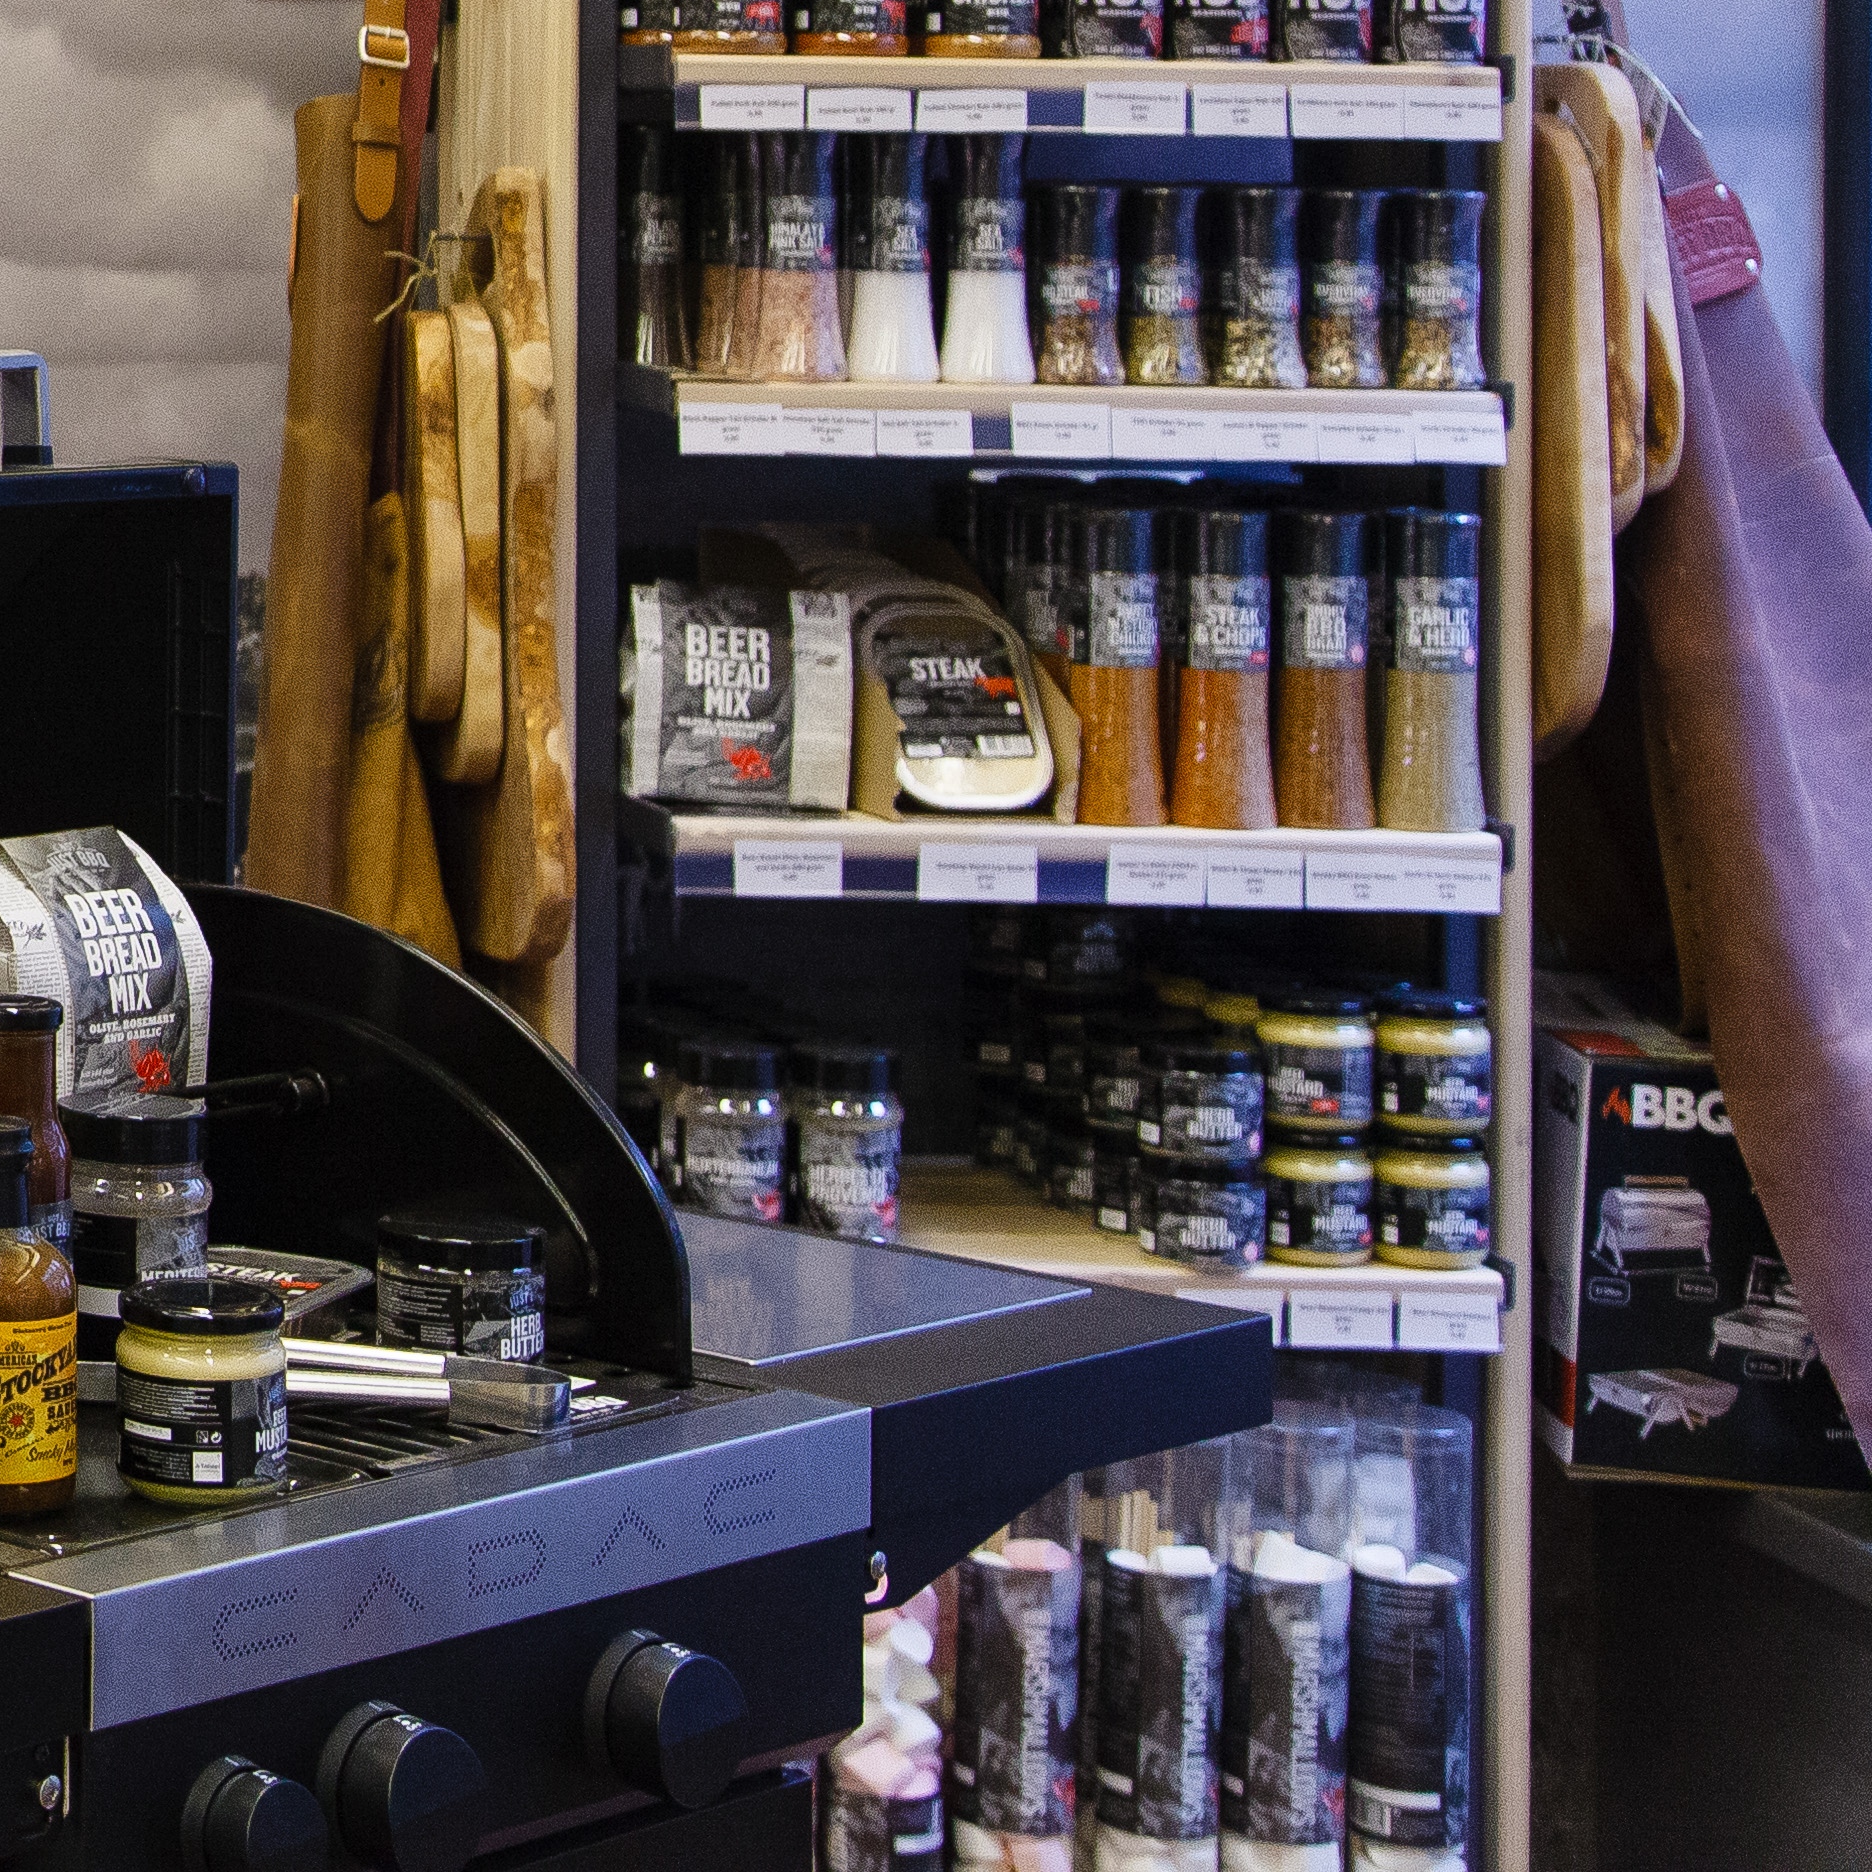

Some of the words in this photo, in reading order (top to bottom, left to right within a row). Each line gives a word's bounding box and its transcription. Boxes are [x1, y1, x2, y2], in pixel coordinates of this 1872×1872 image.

[686, 623, 770, 660] BEER
[686, 657, 770, 690] BREAD
[908, 657, 987, 682] STEAK
[704, 687, 750, 718] MIX
[64, 887, 154, 939] BEER
[82, 932, 163, 978] BREAD
[108, 973, 153, 1015] MIX
[212, 1468, 777, 1662] CADAC
